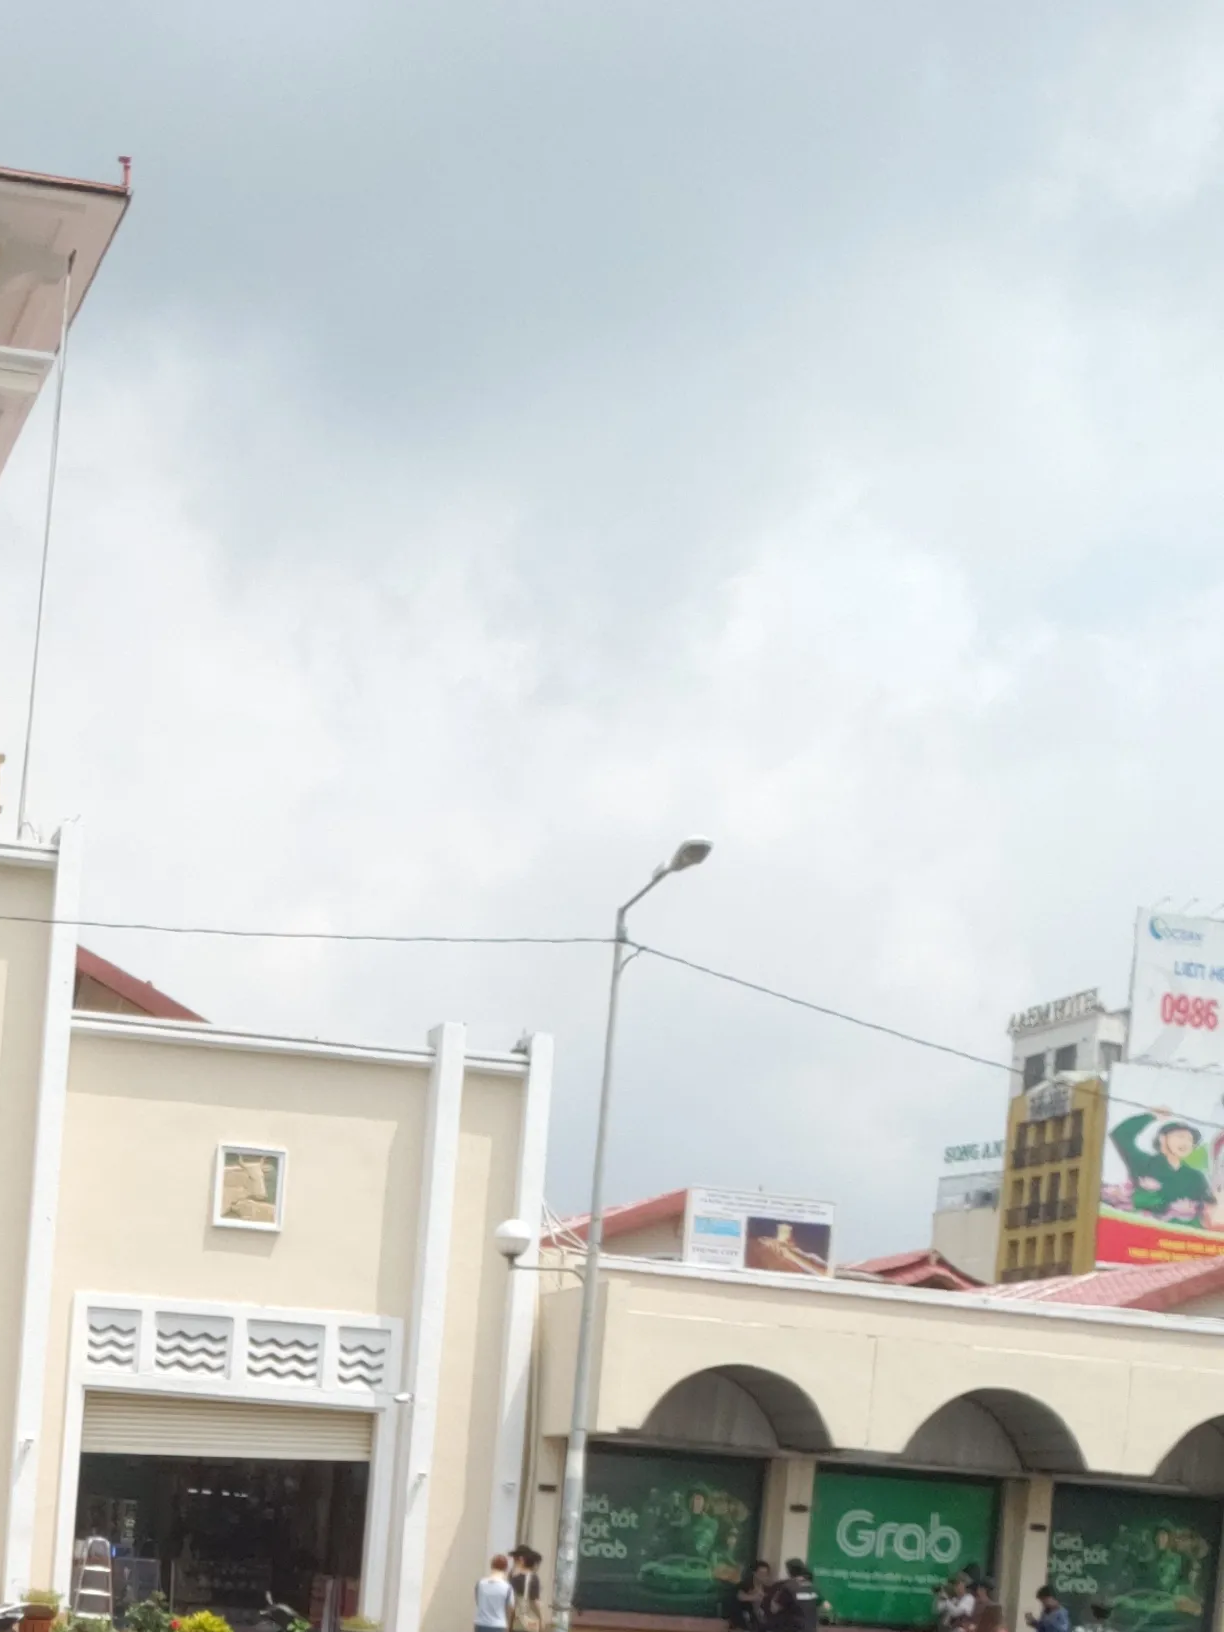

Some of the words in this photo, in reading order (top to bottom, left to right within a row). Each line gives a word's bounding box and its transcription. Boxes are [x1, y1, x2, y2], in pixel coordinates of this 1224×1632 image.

[1161, 993, 1219, 1031] 0986
[579, 1539, 628, 1559] Grab
[836, 1509, 962, 1563] Grab
[1056, 1574, 1098, 1594] Grab
